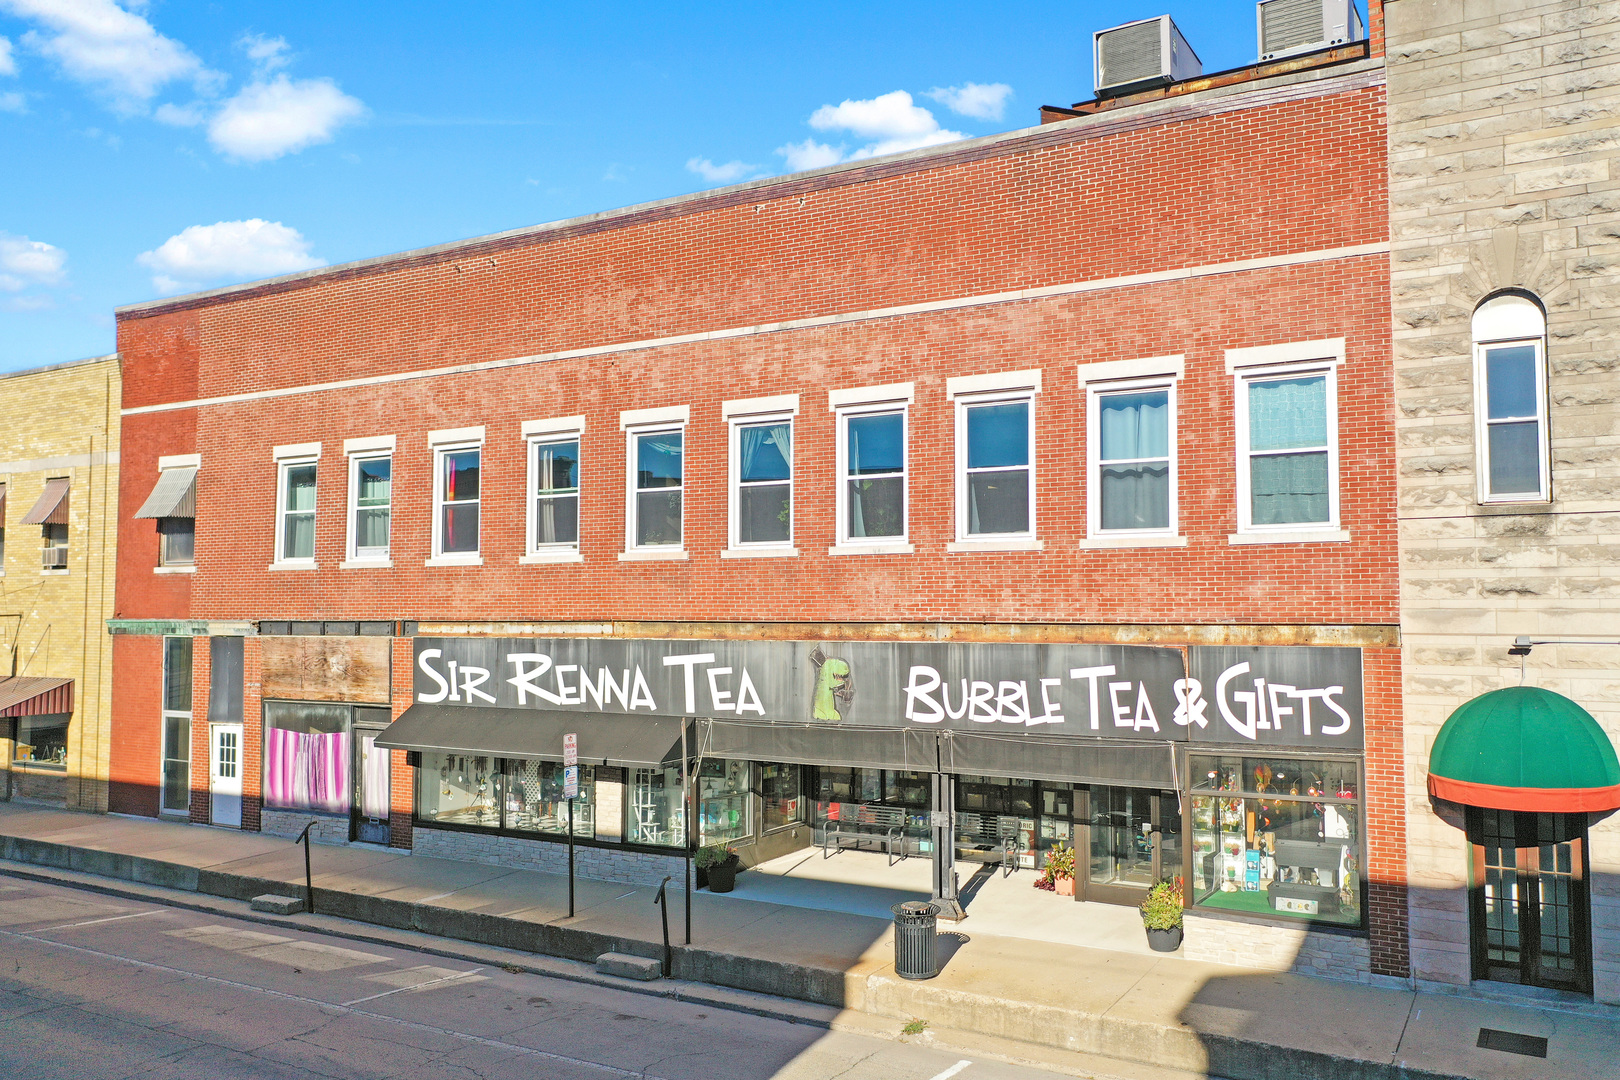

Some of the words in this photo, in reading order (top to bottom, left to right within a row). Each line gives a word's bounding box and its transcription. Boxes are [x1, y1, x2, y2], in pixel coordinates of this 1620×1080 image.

[418, 649, 496, 704] SIR
[506, 653, 657, 711] RENNA
[663, 653, 766, 716] TEA
[903, 665, 1065, 727] BUBBLE
[1070, 665, 1160, 733] TEA
[1173, 678, 1208, 730] &
[1216, 661, 1351, 740] GIFTS
